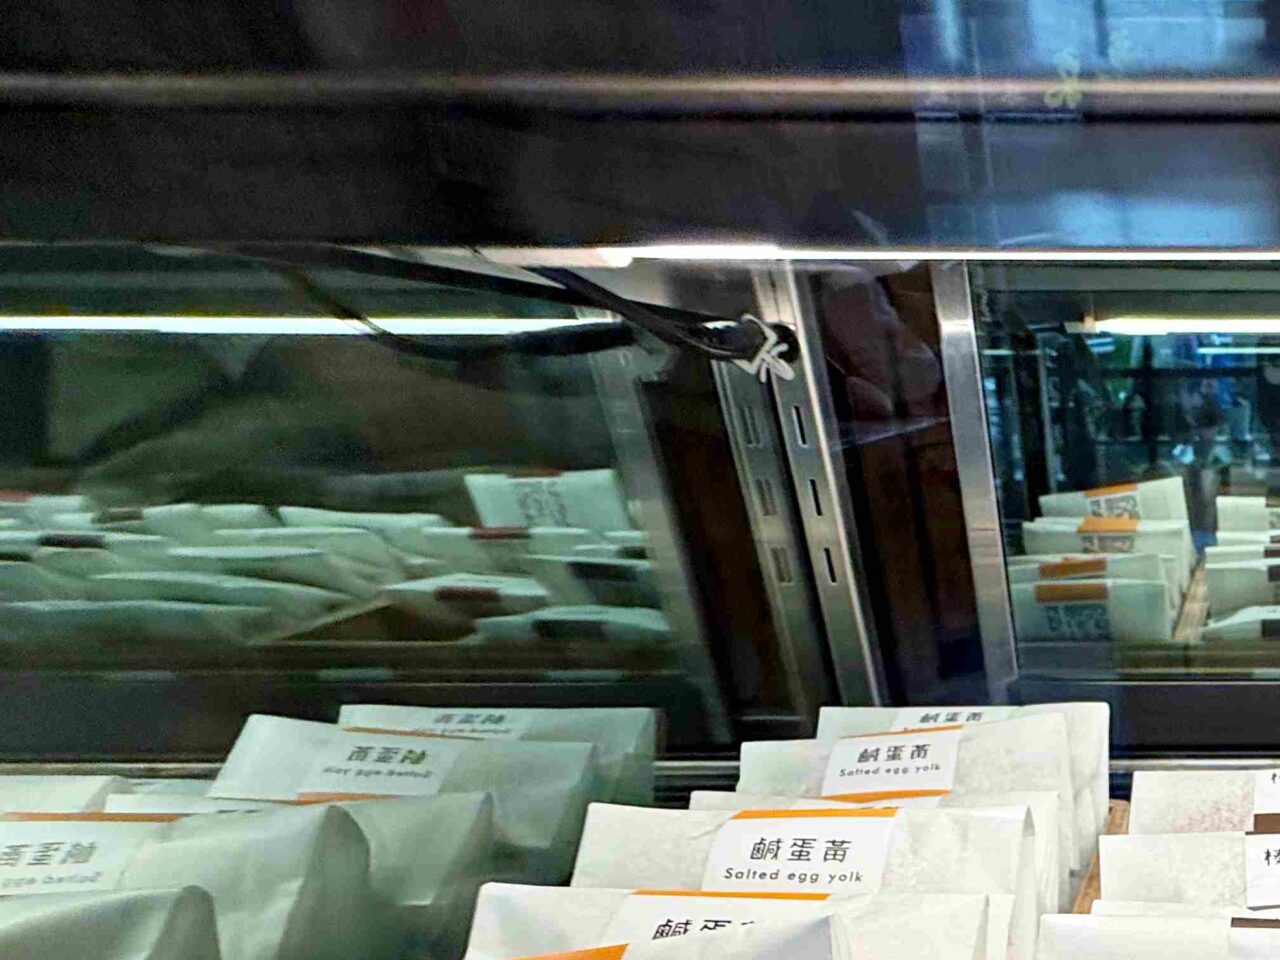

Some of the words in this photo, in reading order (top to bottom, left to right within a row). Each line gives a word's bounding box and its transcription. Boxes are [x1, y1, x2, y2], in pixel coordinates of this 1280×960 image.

[857, 743, 932, 764] 鹹蛋黃
[838, 764, 881, 777] Salted
[884, 766, 909, 775] egg
[914, 763, 941, 774] yolk
[750, 837, 853, 863] 鹹蛋黃
[724, 867, 780, 881] Salted
[787, 871, 820, 884] egg
[828, 871, 864, 884] yolk
